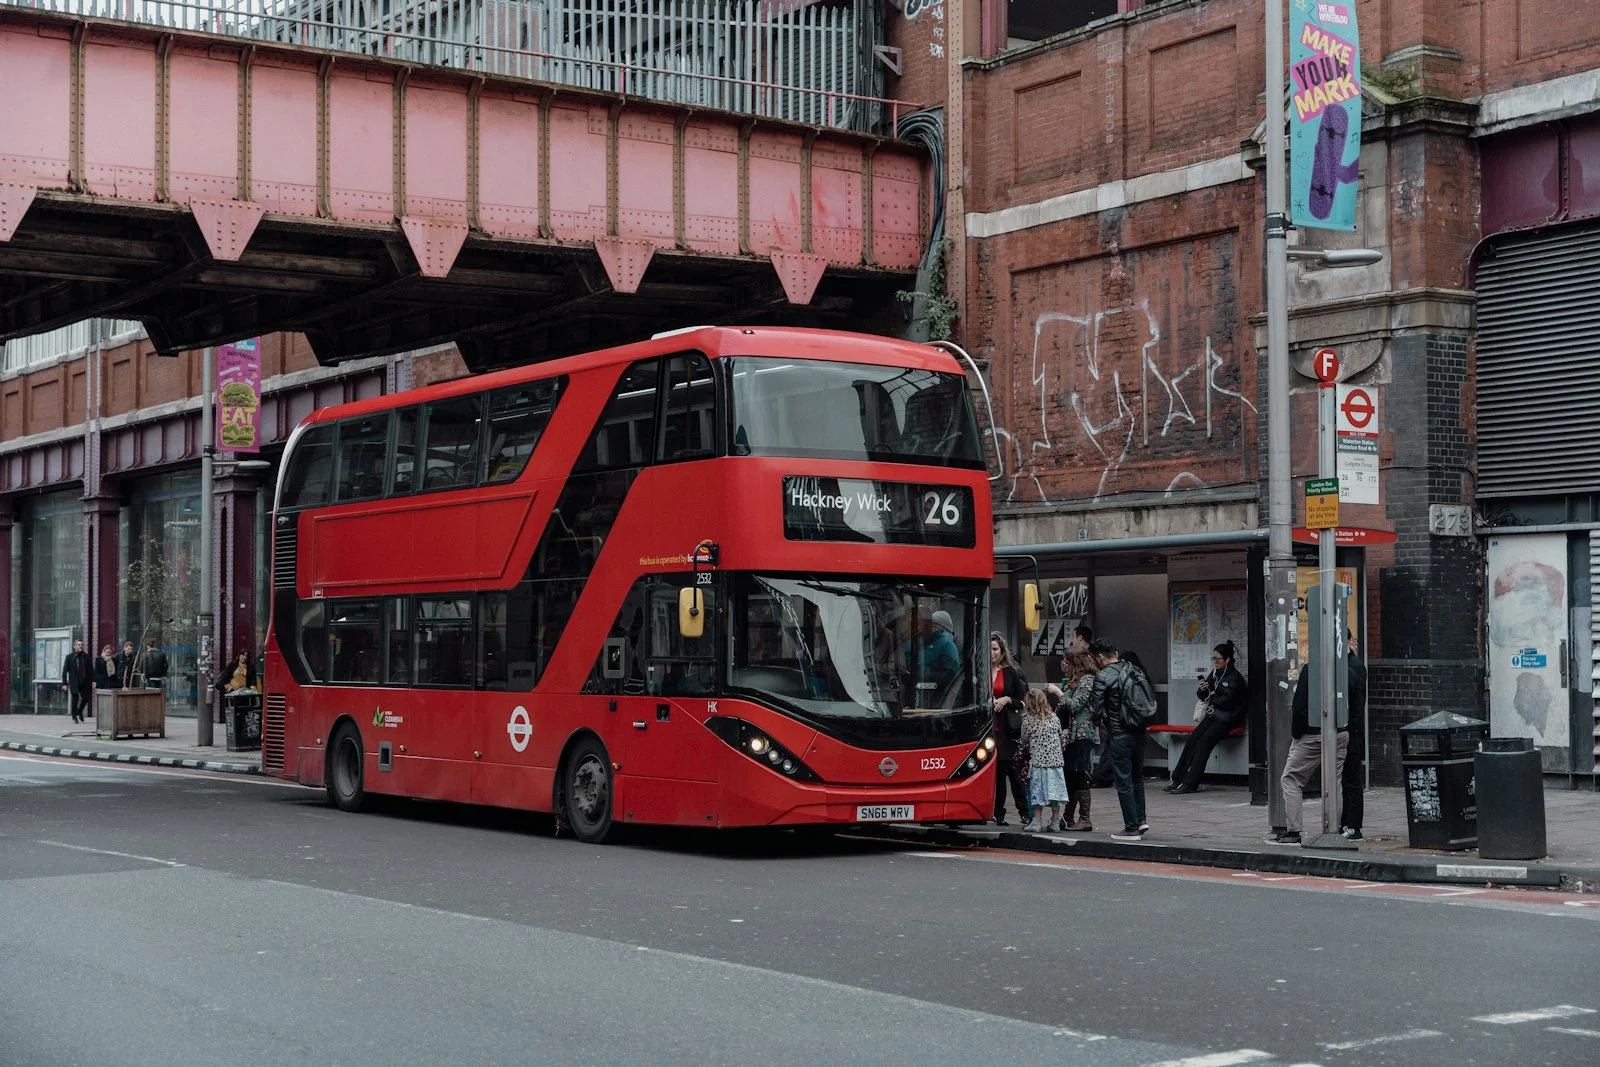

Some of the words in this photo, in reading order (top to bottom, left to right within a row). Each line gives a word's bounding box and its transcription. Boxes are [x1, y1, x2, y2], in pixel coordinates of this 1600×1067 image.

[1302, 25, 1352, 65] MAKE
[1295, 55, 1348, 90] YOUR
[1294, 73, 1360, 119] MARK
[1322, 353, 1334, 377] F
[221, 407, 256, 425] EAT
[792, 488, 852, 514] Hackney
[856, 492, 892, 512] Wick
[924, 491, 960, 526] 26
[656, 556, 660, 564] is
[660, 556, 680, 566] operated
[681, 554, 687, 565] by
[697, 573, 712, 584] 2532
[707, 701, 718, 712] HK
[921, 758, 946, 770] 12532
[861, 807, 887, 819] SN66
[890, 806, 910, 818] WRV
